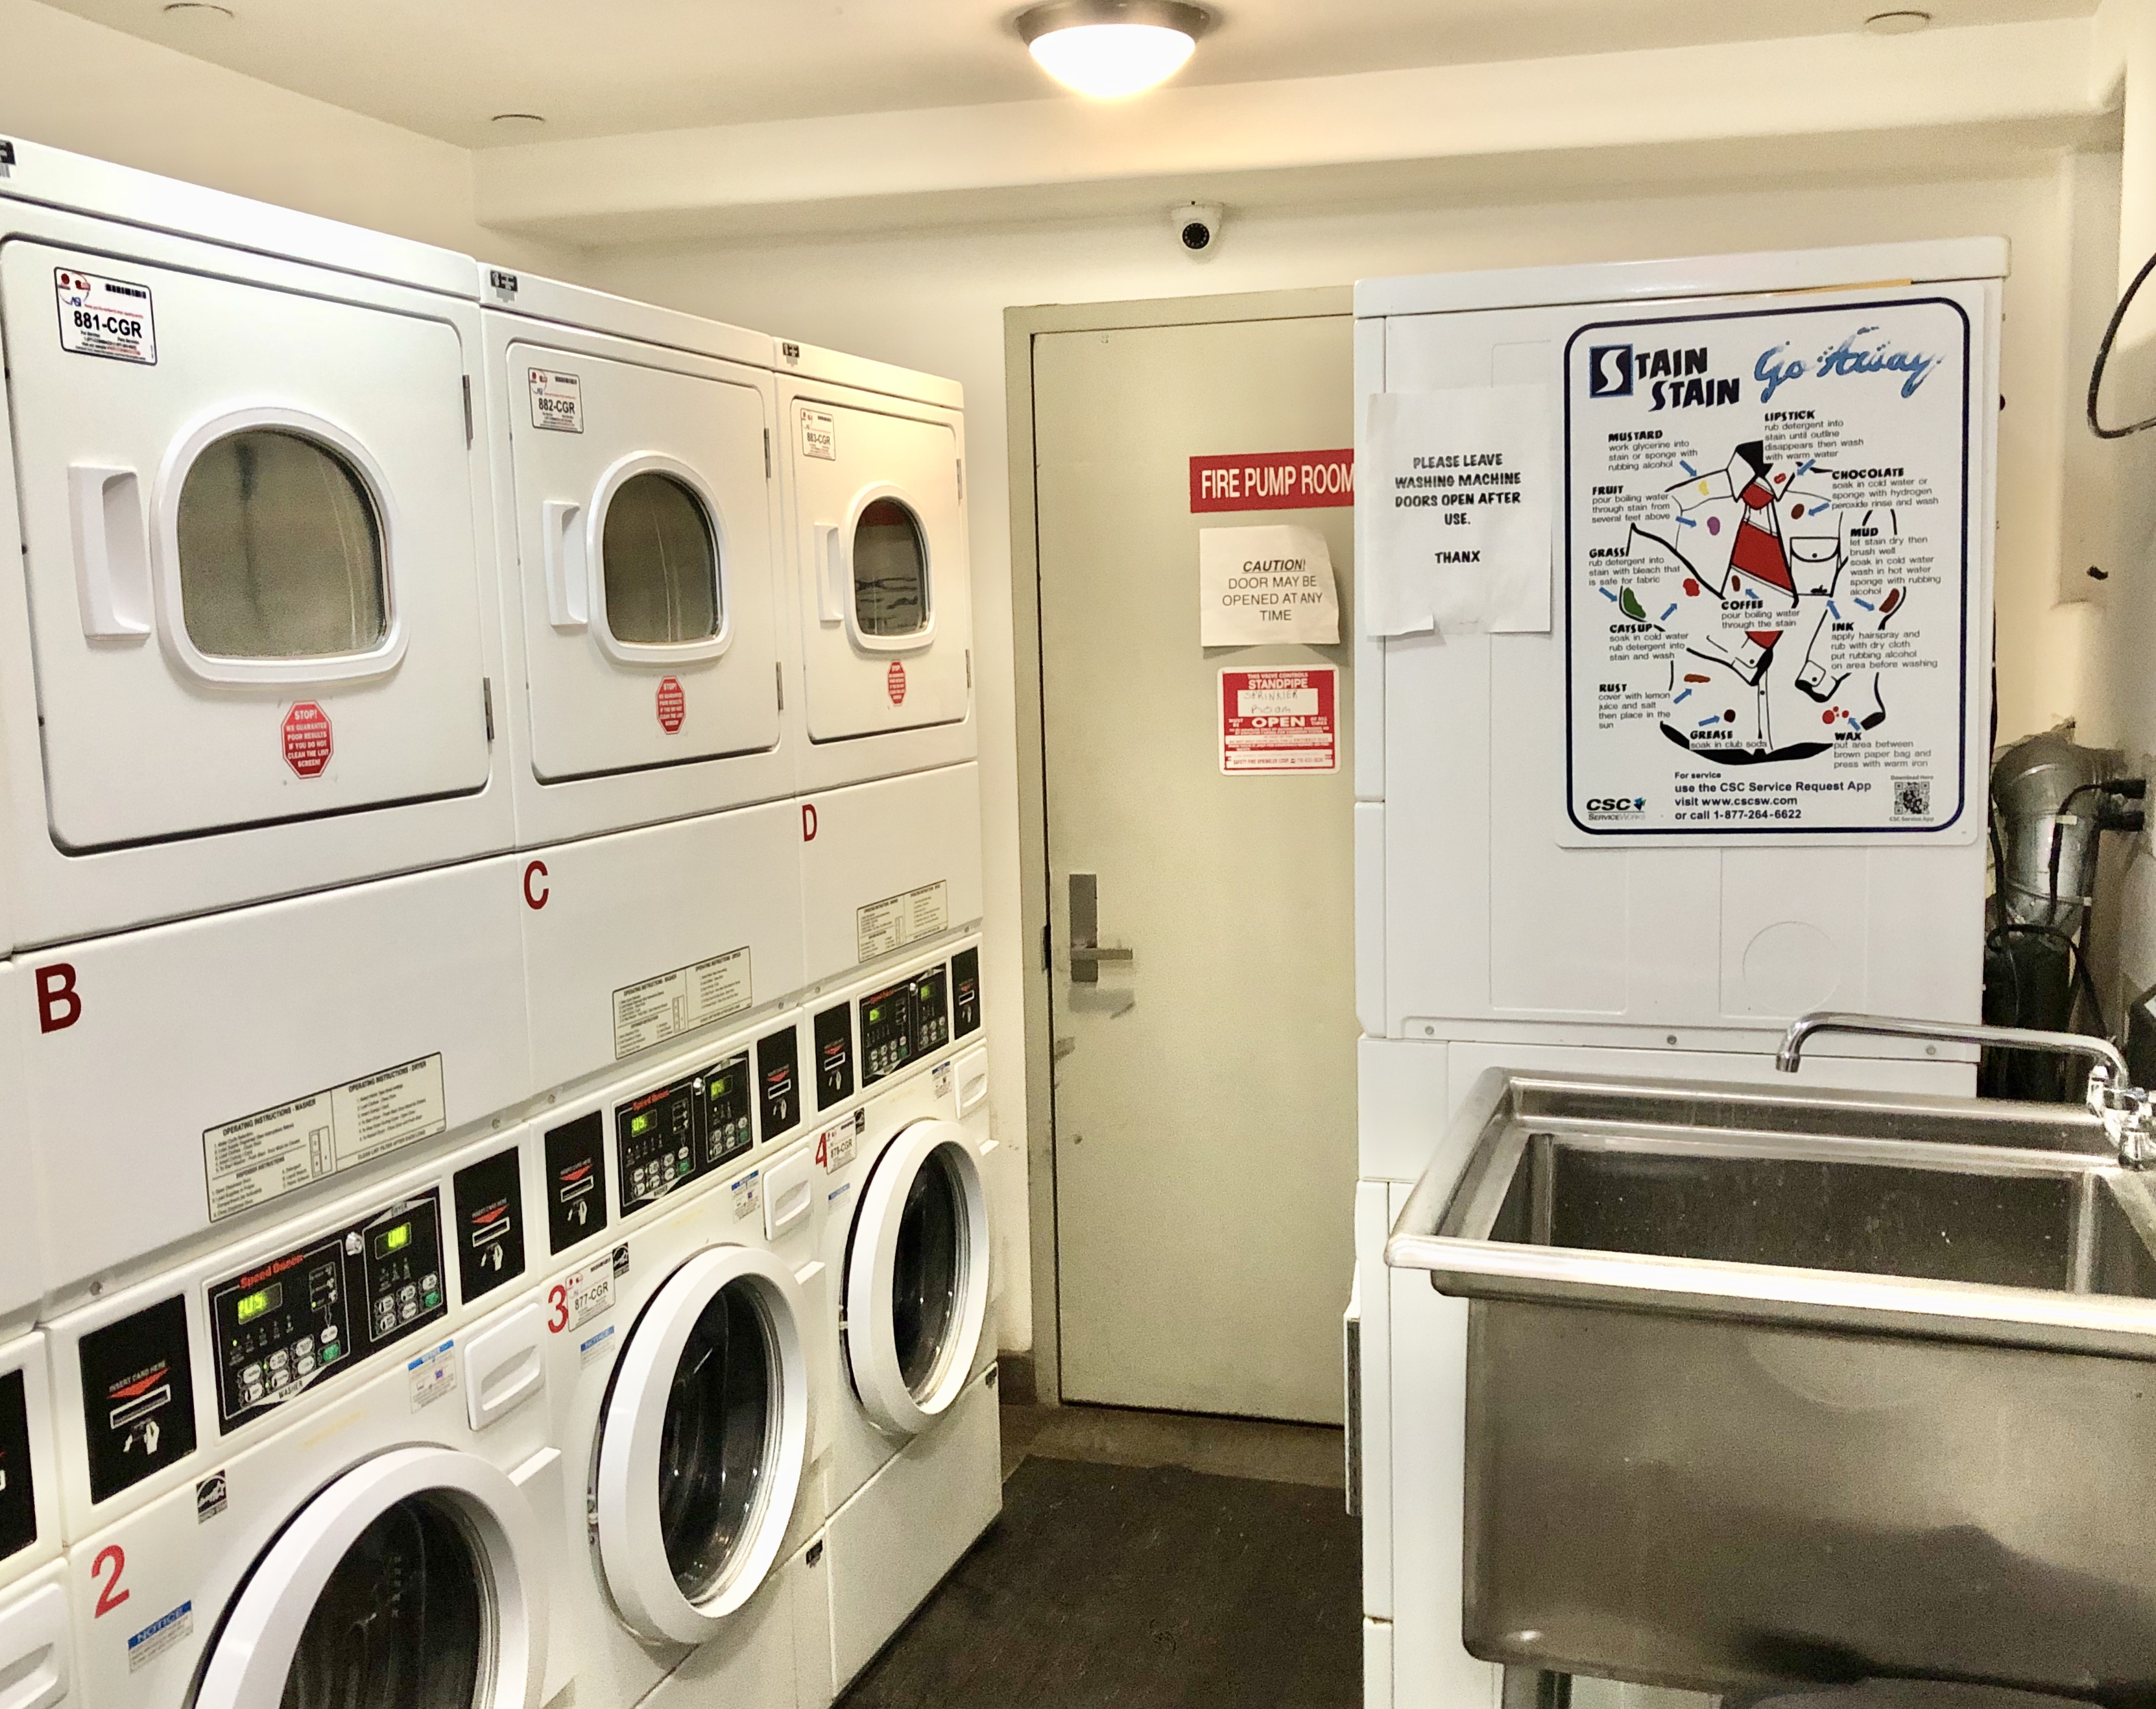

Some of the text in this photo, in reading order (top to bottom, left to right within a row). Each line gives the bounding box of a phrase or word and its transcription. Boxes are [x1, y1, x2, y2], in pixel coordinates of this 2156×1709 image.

[74, 311, 142, 338] 881-CGR
[1593, 343, 1810, 403] STAIN Go
[1648, 377, 1740, 412] STAIN
[538, 398, 575, 415] 882-CGR
[1764, 410, 1815, 422] LIPSTICK
[1764, 419, 1844, 432] rub detergent into
[807, 432, 831, 446] 883-CGR
[1608, 429, 1663, 442] MUSTARD
[1764, 429, 1840, 441] stain until outline
[1608, 439, 1690, 453] work glycerine into
[1764, 438, 1864, 453] disappears then wash
[1413, 453, 1503, 469] PLEASE LEAVE
[1608, 453, 1629, 462] stain
[1644, 451, 1677, 462] sponge
[1680, 449, 1698, 457] with
[1765, 453, 1784, 461] with
[1814, 449, 1839, 459] water
[1608, 460, 1673, 473] rubbing alcohol
[1395, 472, 1521, 488] WASHING MACHINE
[1832, 467, 1904, 480] CHOCOLATE
[1202, 463, 1354, 499] FIRE PUMP ROOM
[1592, 485, 1624, 495] FRUIT
[1395, 492, 1521, 508] DOORS OPEN AFTER
[1592, 492, 1670, 506] pour boiling water
[1592, 502, 1670, 515] through stain from
[1444, 512, 1471, 525] USE.
[1591, 512, 1671, 523] several feet above
[1850, 528, 1879, 536] MUD
[1434, 550, 1481, 564] THANX
[1589, 547, 1627, 558] GRASS
[1243, 558, 1306, 573] CAUTION!
[1228, 575, 1317, 590] DOOR MAY BE
[1222, 592, 1323, 606] OPENED AT ANY
[1721, 600, 1763, 610] COFFEE
[1260, 610, 1292, 621] TIME
[1609, 624, 1652, 633] CATSUP
[1832, 622, 1854, 631] INK
[1248, 678, 1308, 689] STANDPIPE
[1599, 684, 1627, 692] RUST
[1644, 691, 1671, 699] lemon
[1598, 701, 1619, 711] juice
[1640, 700, 1657, 709] salt
[294, 710, 318, 720] STOP!
[1251, 716, 1305, 727] OPEN
[1598, 711, 1618, 719] then
[1620, 710, 1644, 721] place
[1657, 710, 1671, 718] the
[1690, 730, 1733, 739] GREASE
[1835, 732, 1862, 741] WAX
[1689, 740, 1711, 748] soak
[1724, 739, 1743, 748] club
[1832, 741, 1849, 750] put
[1875, 739, 1914, 748] between
[1863, 751, 1891, 759] paper
[1893, 750, 1911, 759] bag
[1914, 749, 1932, 758] and
[1833, 761, 1859, 770] press
[1911, 759, 1928, 767] iron
[1690, 771, 1721, 779] service
[1698, 783, 1717, 793] the
[1719, 782, 1745, 792] CSC
[1749, 782, 1792, 792] Service
[1795, 782, 1844, 793] Request
[1847, 781, 1872, 793] App
[1586, 798, 1631, 811] CSC
[1674, 796, 1798, 806] visit www.cscsw.com
[1690, 810, 1710, 819] call
[1713, 809, 1802, 819] 1-877-264-6622
[802, 804, 817, 842] D
[523, 860, 549, 911] C
[35, 962, 82, 1034] B
[222, 1098, 316, 1136] OPERATING INSTRUCTIONS WASHER
[815, 1132, 827, 1168] 4
[575, 1281, 608, 1310] 877-CGR
[548, 1284, 568, 1333] 3
[109, 1376, 131, 1392] INSERT
[278, 1380, 303, 1399] WASHER
[91, 1544, 130, 1618] 2
